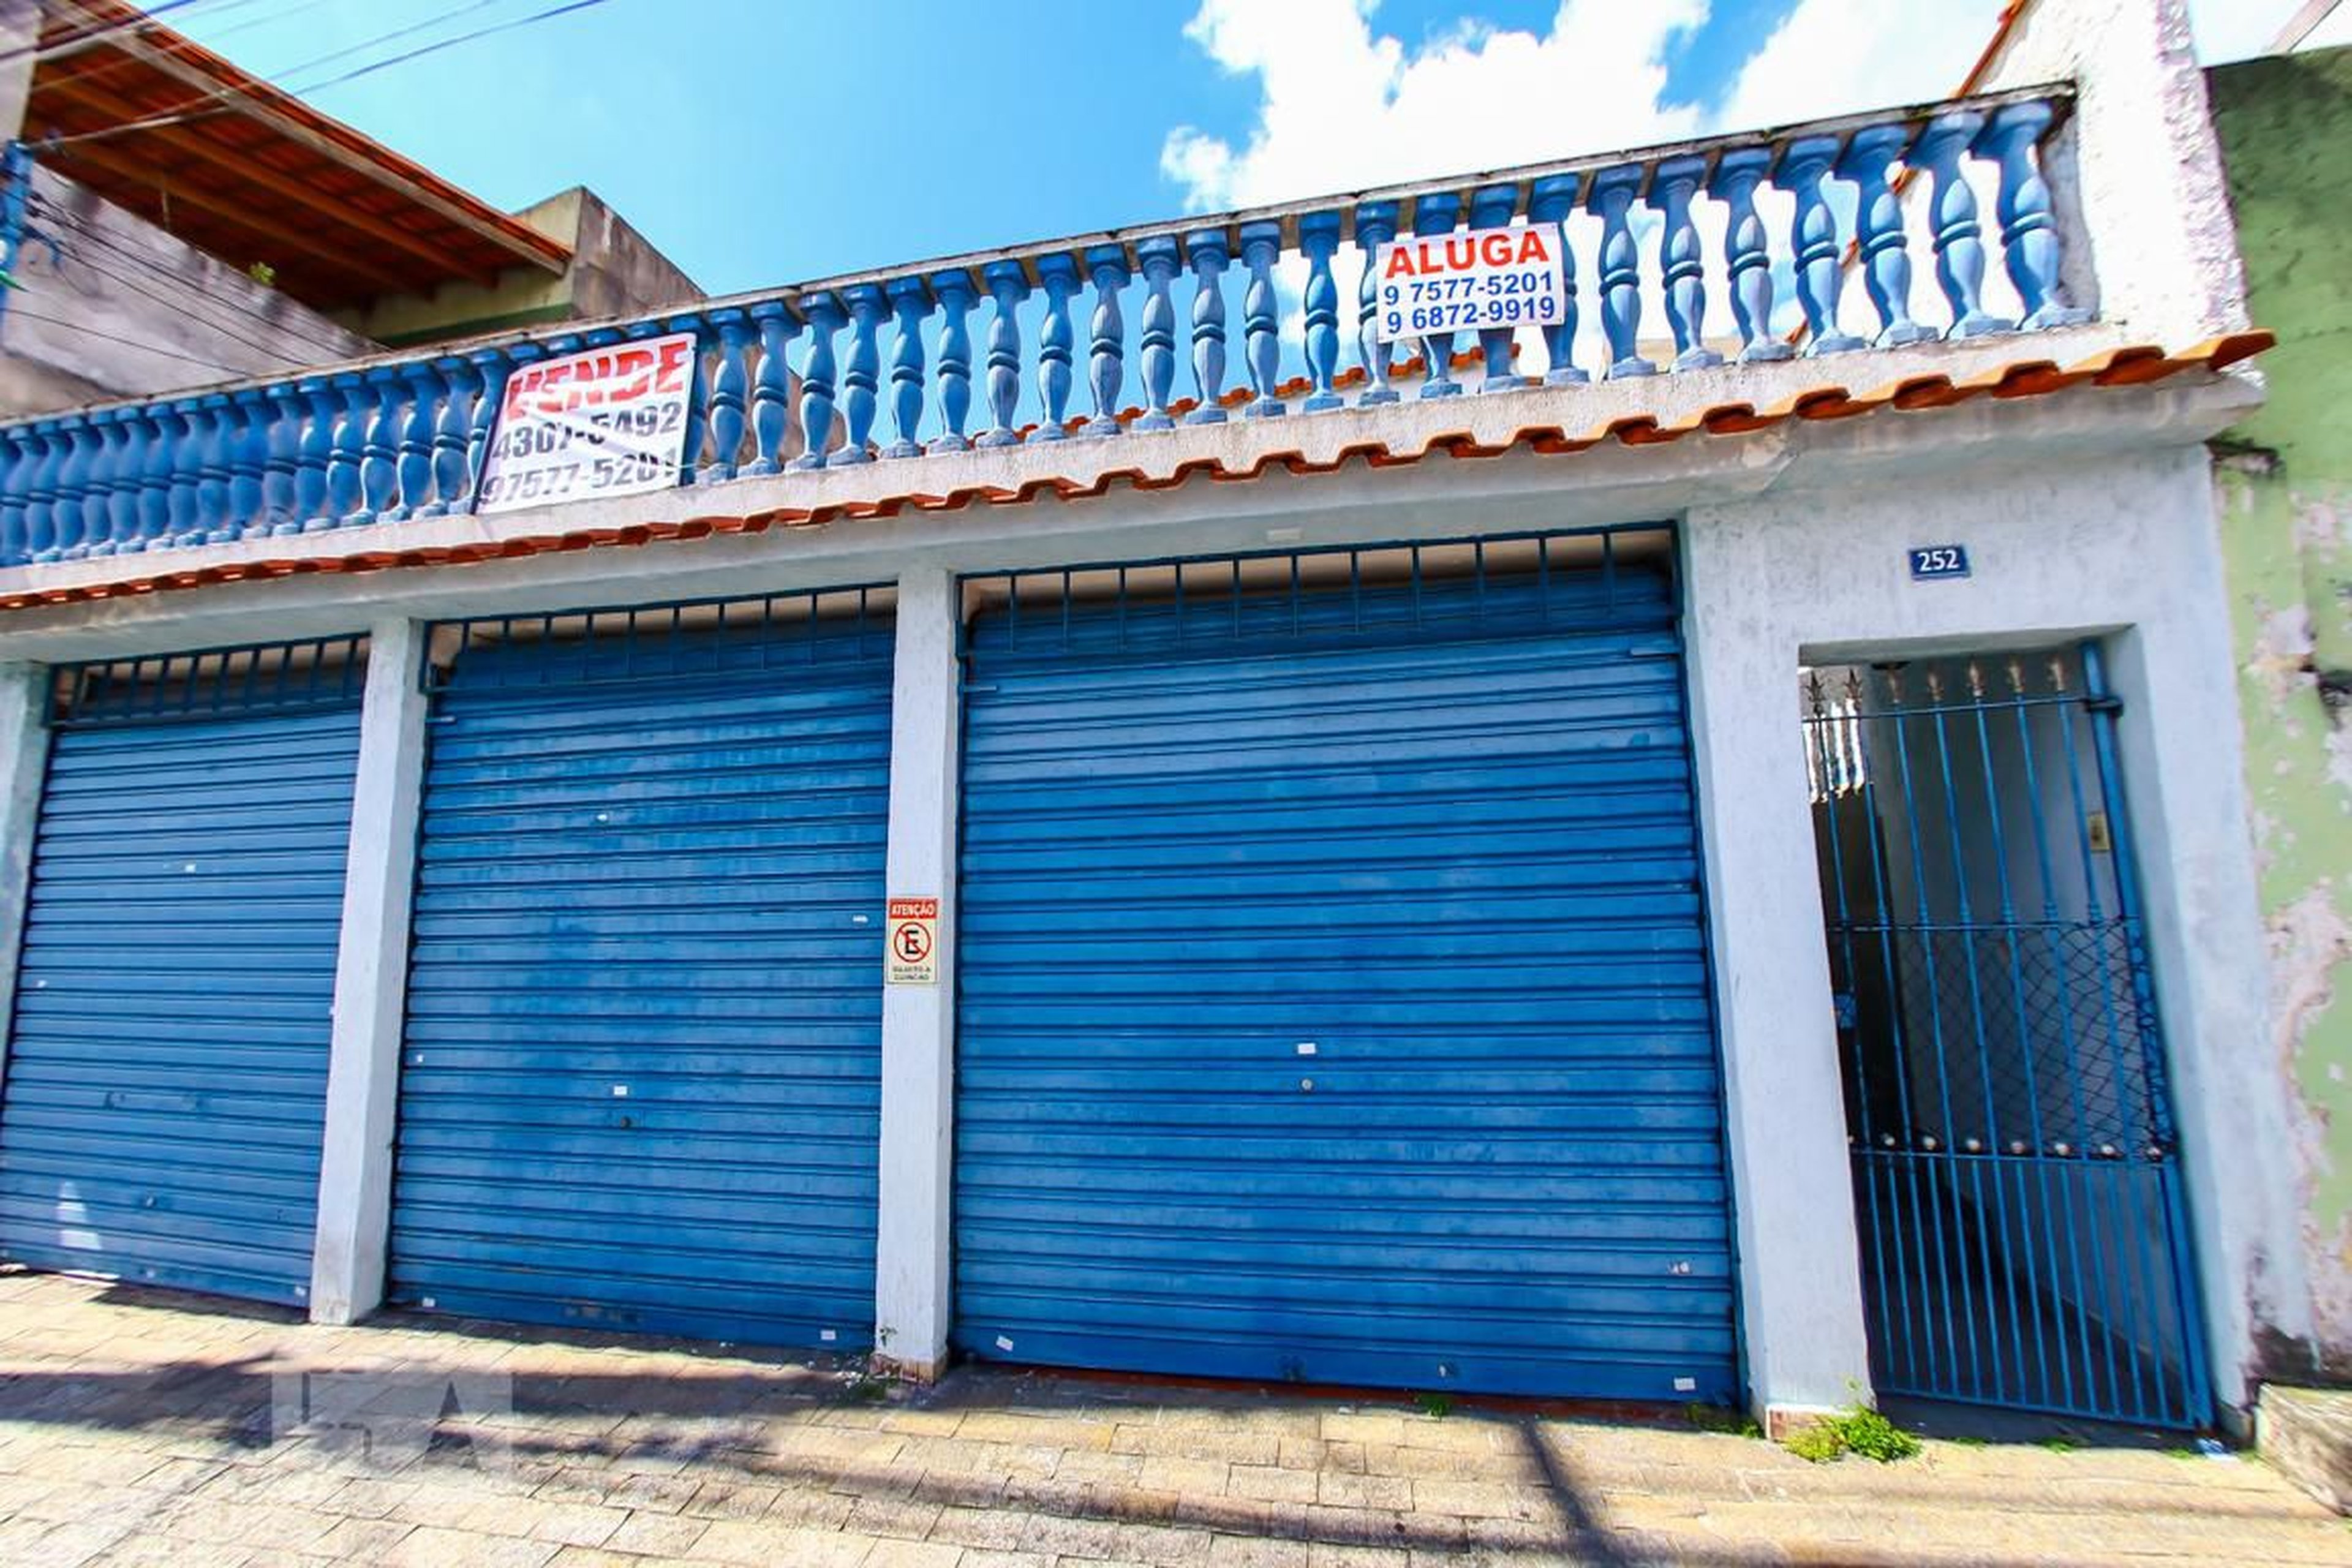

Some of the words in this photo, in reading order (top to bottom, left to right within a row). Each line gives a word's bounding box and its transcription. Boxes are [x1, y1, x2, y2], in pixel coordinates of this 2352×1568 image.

[1385, 230, 1550, 279] ALUGA
[1384, 285, 1400, 306] 9
[1410, 271, 1552, 303] 7577-5201
[1387, 311, 1402, 334] 9
[1412, 296, 1555, 330] 6872-9919
[1918, 549, 1959, 571] 252
[892, 901, 935, 918] ATENÇÃO
